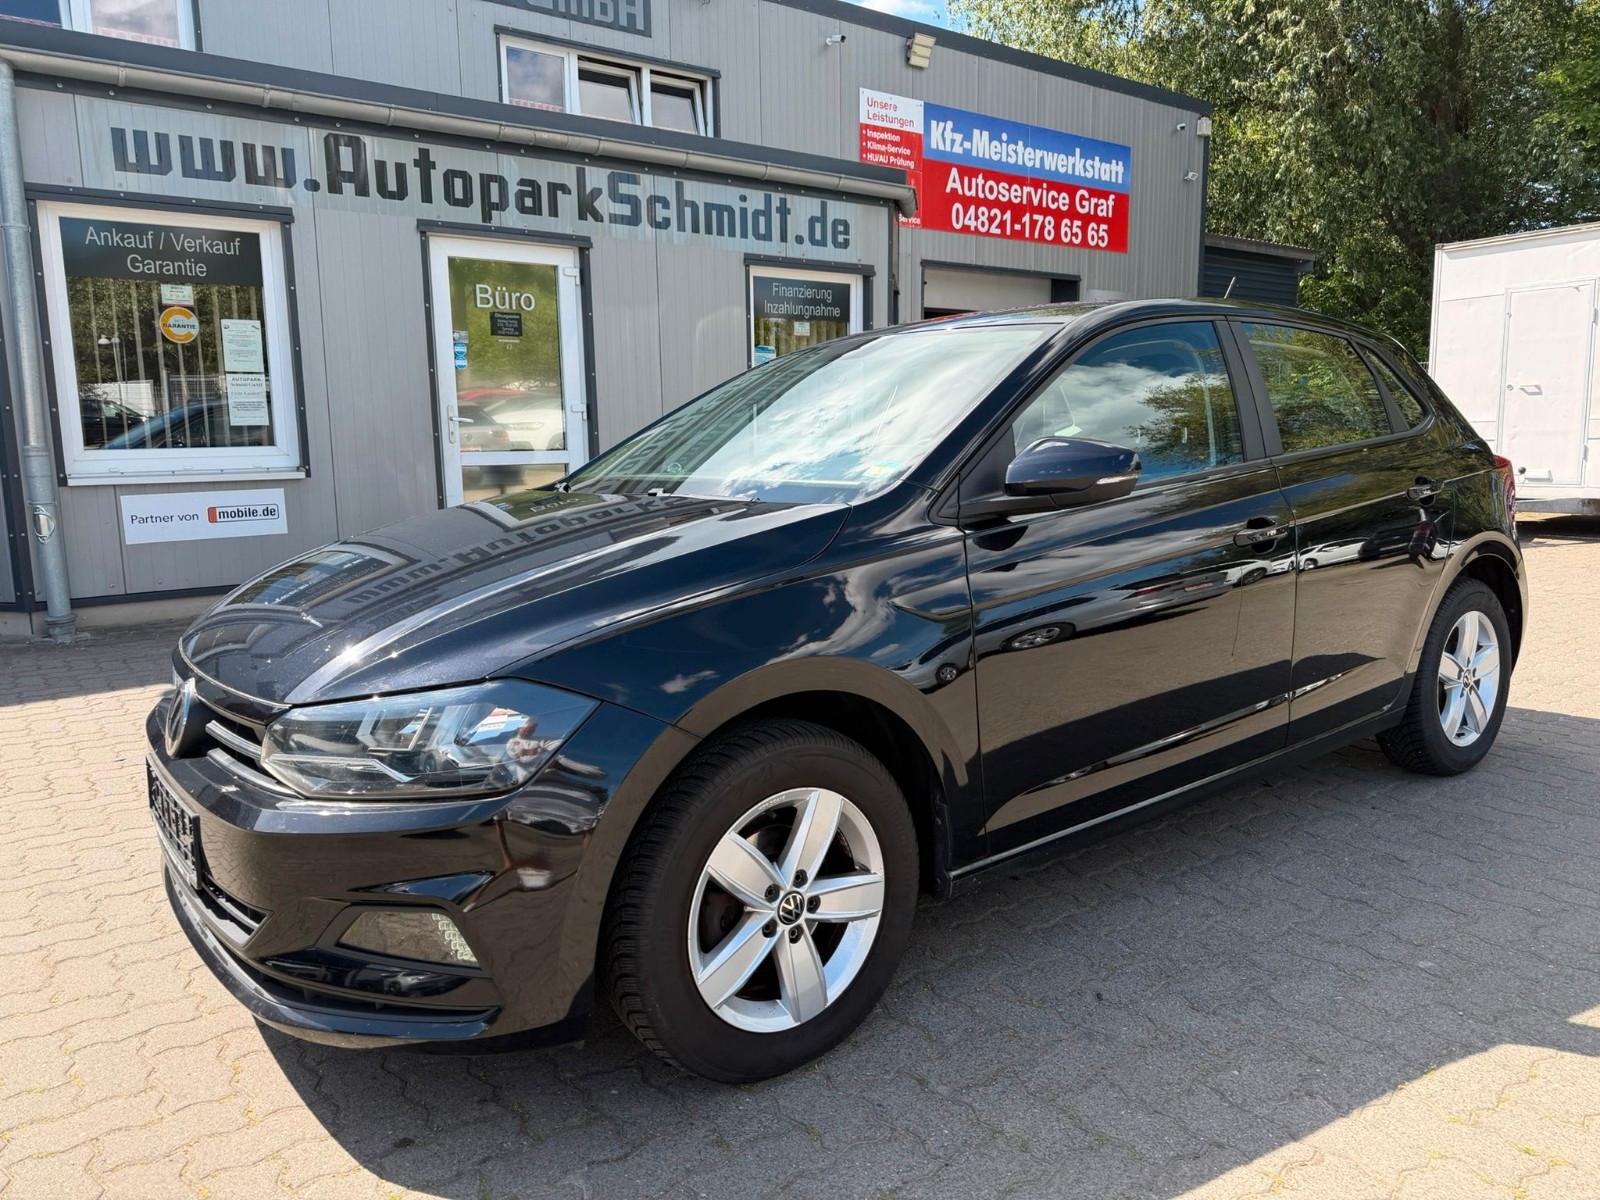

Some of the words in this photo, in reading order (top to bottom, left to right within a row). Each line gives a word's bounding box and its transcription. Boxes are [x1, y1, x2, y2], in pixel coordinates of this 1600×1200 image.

[525, 0, 645, 30] mbH
[867, 96, 898, 111] Unsere
[867, 110, 915, 129] Leistungen
[866, 128, 901, 143] Inspektion
[866, 140, 912, 156] Klima-Service
[930, 119, 1124, 184] Kfz-Meisterwerkstatt
[867, 153, 888, 164] HU/AU
[889, 156, 915, 169] Prüfung
[110, 127, 850, 249] www.AutoparkSchmidt.de
[945, 167, 1070, 211] Autoservice
[1074, 189, 1115, 218] Graf
[951, 202, 1055, 241] 04821-178
[1060, 218, 1082, 245] 65
[1087, 222, 1109, 248] 65
[85, 226, 154, 250] Ankauf
[170, 232, 241, 256] Verkauf
[127, 254, 207, 277] Garantie
[476, 284, 534, 310] Büro
[772, 282, 832, 303] Finanzierung
[764, 300, 841, 319] Inzahlungnahme
[130, 513, 175, 524] Partner
[179, 513, 199, 522] von
[218, 506, 277, 520] mobile.de
